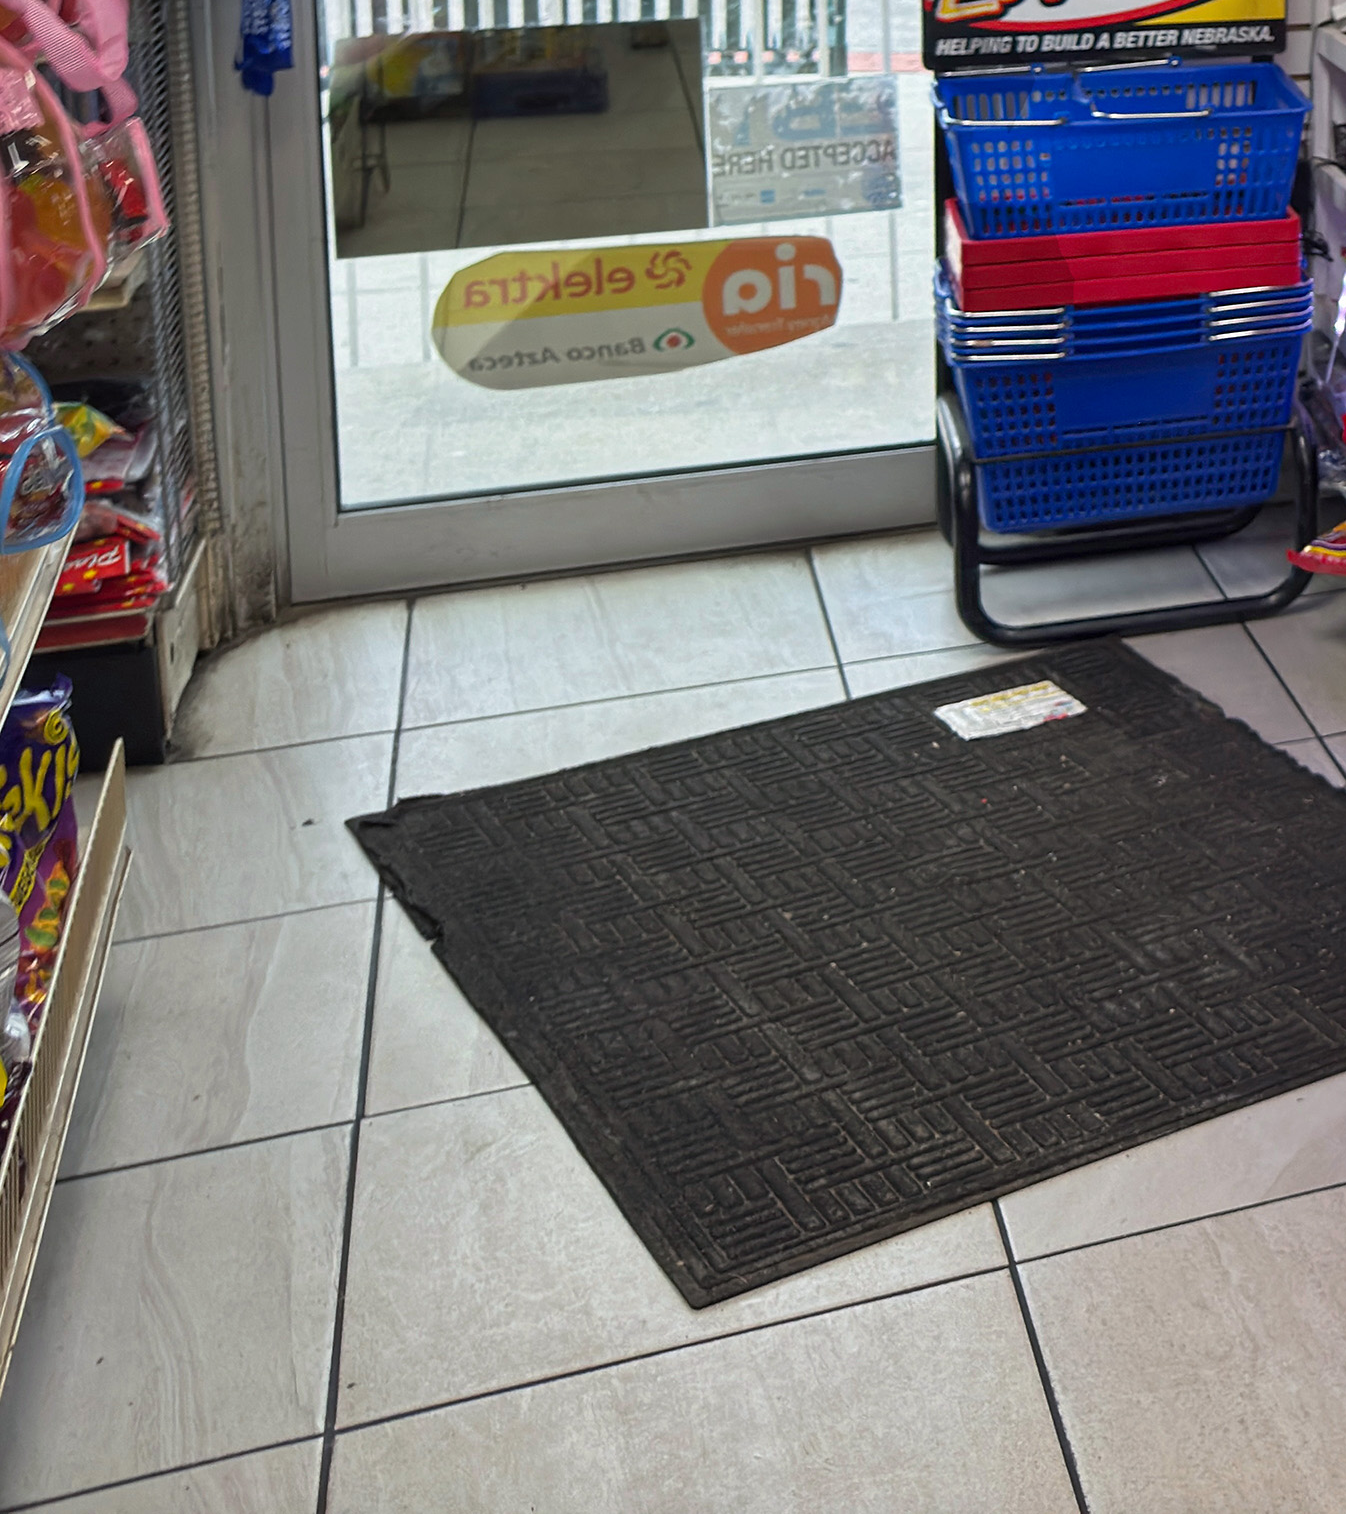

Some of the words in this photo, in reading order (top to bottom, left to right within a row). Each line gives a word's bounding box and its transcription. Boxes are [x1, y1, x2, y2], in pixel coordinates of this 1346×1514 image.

[935, 37, 1014, 57] HELPING
[1017, 35, 1043, 53] TO
[1044, 33, 1095, 53] BUILD
[1096, 32, 1111, 49] A
[1113, 29, 1179, 49] BETTER
[1182, 24, 1276, 46] NEBRASKA.
